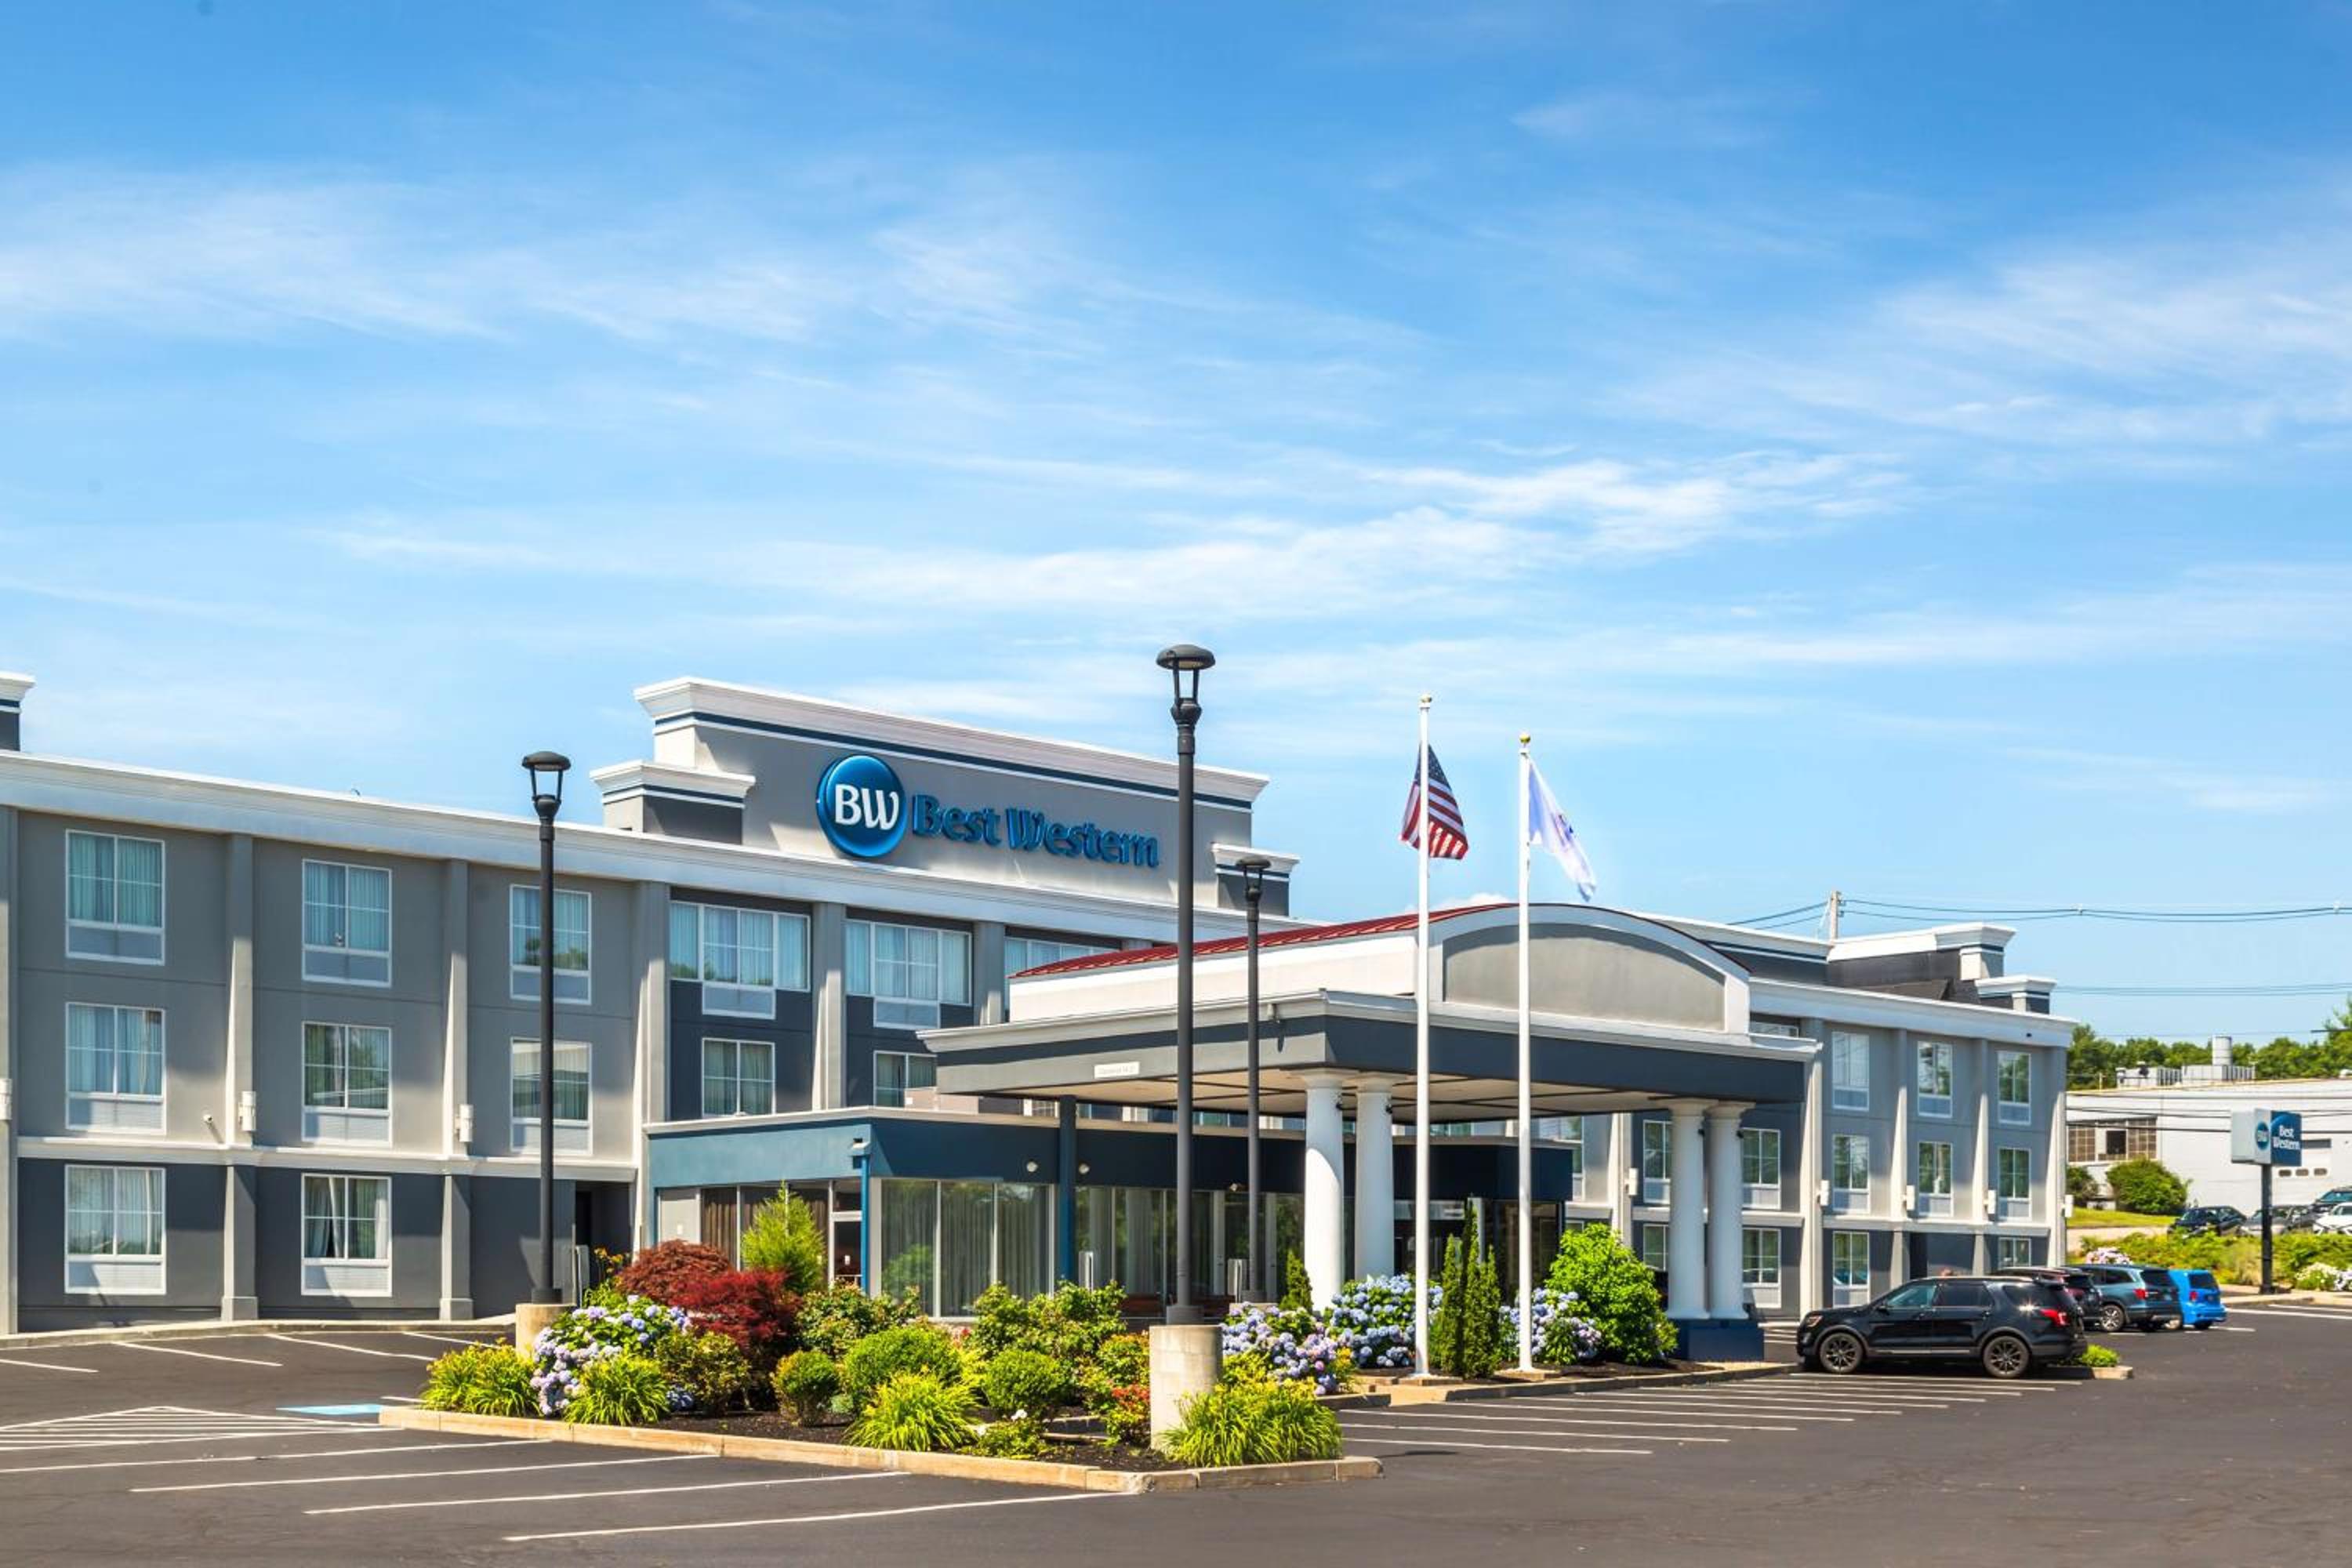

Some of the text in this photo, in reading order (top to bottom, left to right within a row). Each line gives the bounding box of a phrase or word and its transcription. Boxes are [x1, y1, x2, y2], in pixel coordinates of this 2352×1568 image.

[834, 783, 1160, 868] BW Best Western
[2279, 1125, 2294, 1138] Best
